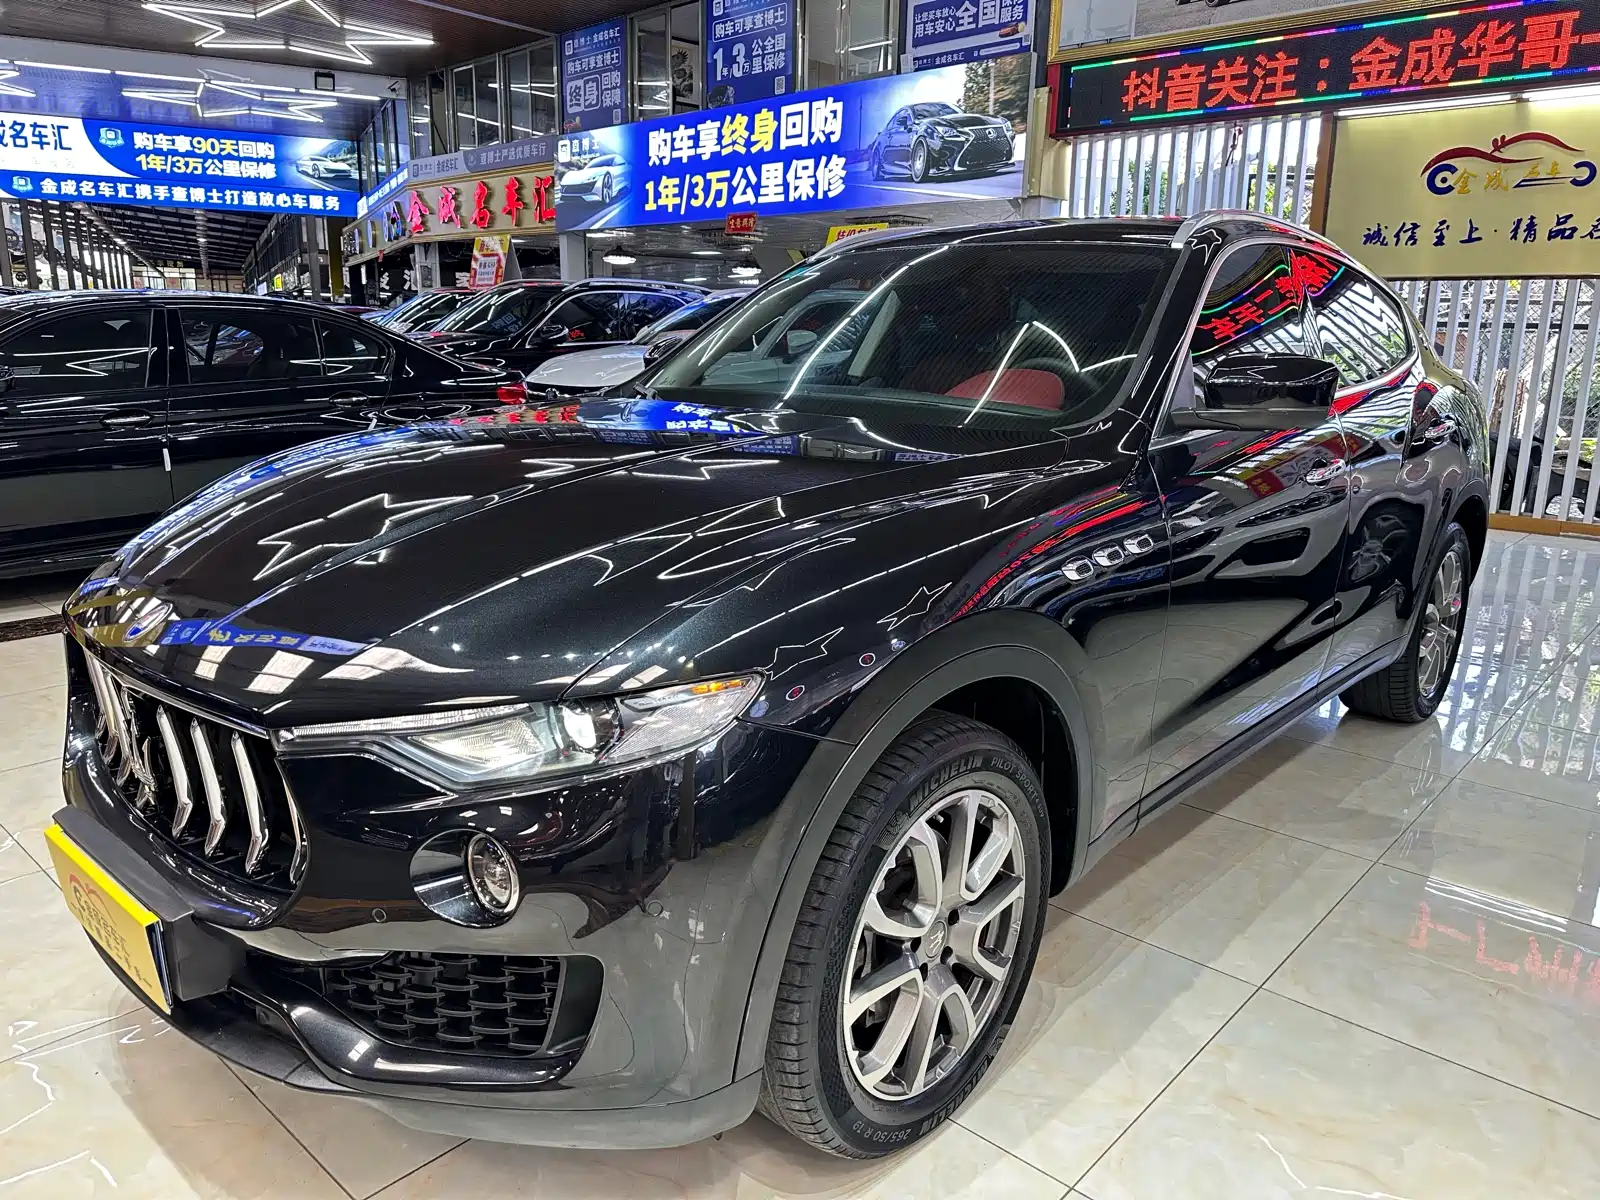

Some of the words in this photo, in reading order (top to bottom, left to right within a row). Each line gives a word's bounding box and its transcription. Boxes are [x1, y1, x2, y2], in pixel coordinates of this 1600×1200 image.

[715, 7, 785, 39] 购车可享查博士
[915, 6, 956, 24] 让您买车放心
[955, 0, 999, 32] 全国
[1000, 5, 1024, 23] 服务
[914, 18, 956, 38] 用车安心
[567, 49, 619, 75] 购车可享查博士
[602, 70, 621, 89] 回购
[568, 80, 599, 109] 终身
[602, 88, 621, 108] 保障
[648, 97, 843, 167] 购车享终身回购
[133, 131, 275, 160] 购车享90天回购
[135, 154, 277, 180] 1年/3万公里保修
[40, 176, 341, 212] 金成名车汇携手查博士打造放心车服务
[644, 154, 847, 215] 1年/3万公里保修
[908, 755, 984, 813] MICHELIN
[991, 756, 1015, 773] PILOT
[1015, 769, 1038, 800] SPORT
[852, 1120, 864, 1131] 19
[872, 1128, 912, 1143] 265/50
